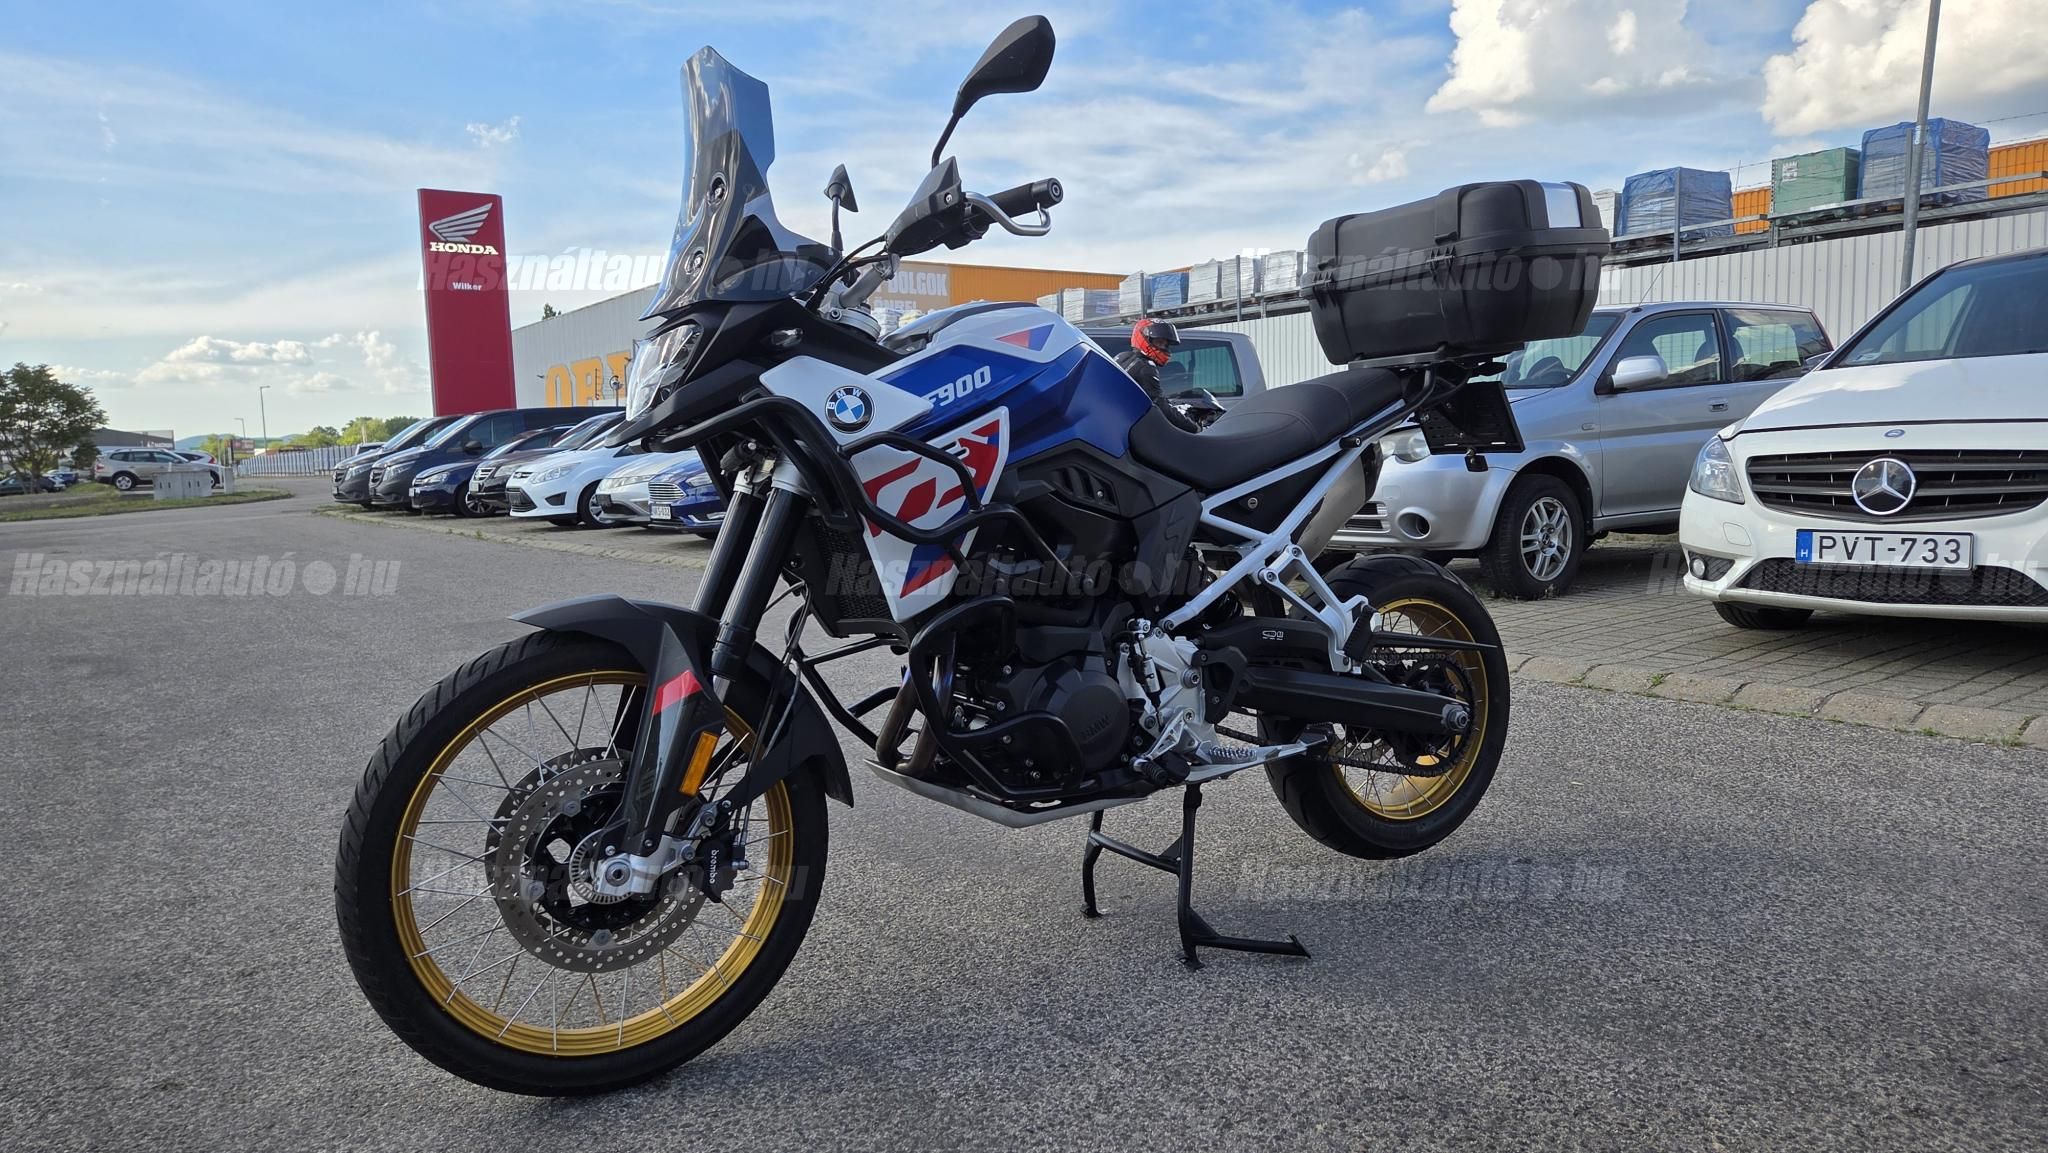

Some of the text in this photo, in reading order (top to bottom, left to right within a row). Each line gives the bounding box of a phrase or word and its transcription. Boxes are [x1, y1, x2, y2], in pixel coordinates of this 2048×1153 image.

[429, 241, 499, 255] HONDA
[826, 387, 863, 410] BMW
[1800, 549, 1809, 558] H
[1818, 535, 1961, 564] PVT-733
[709, 849, 720, 884] brembo
